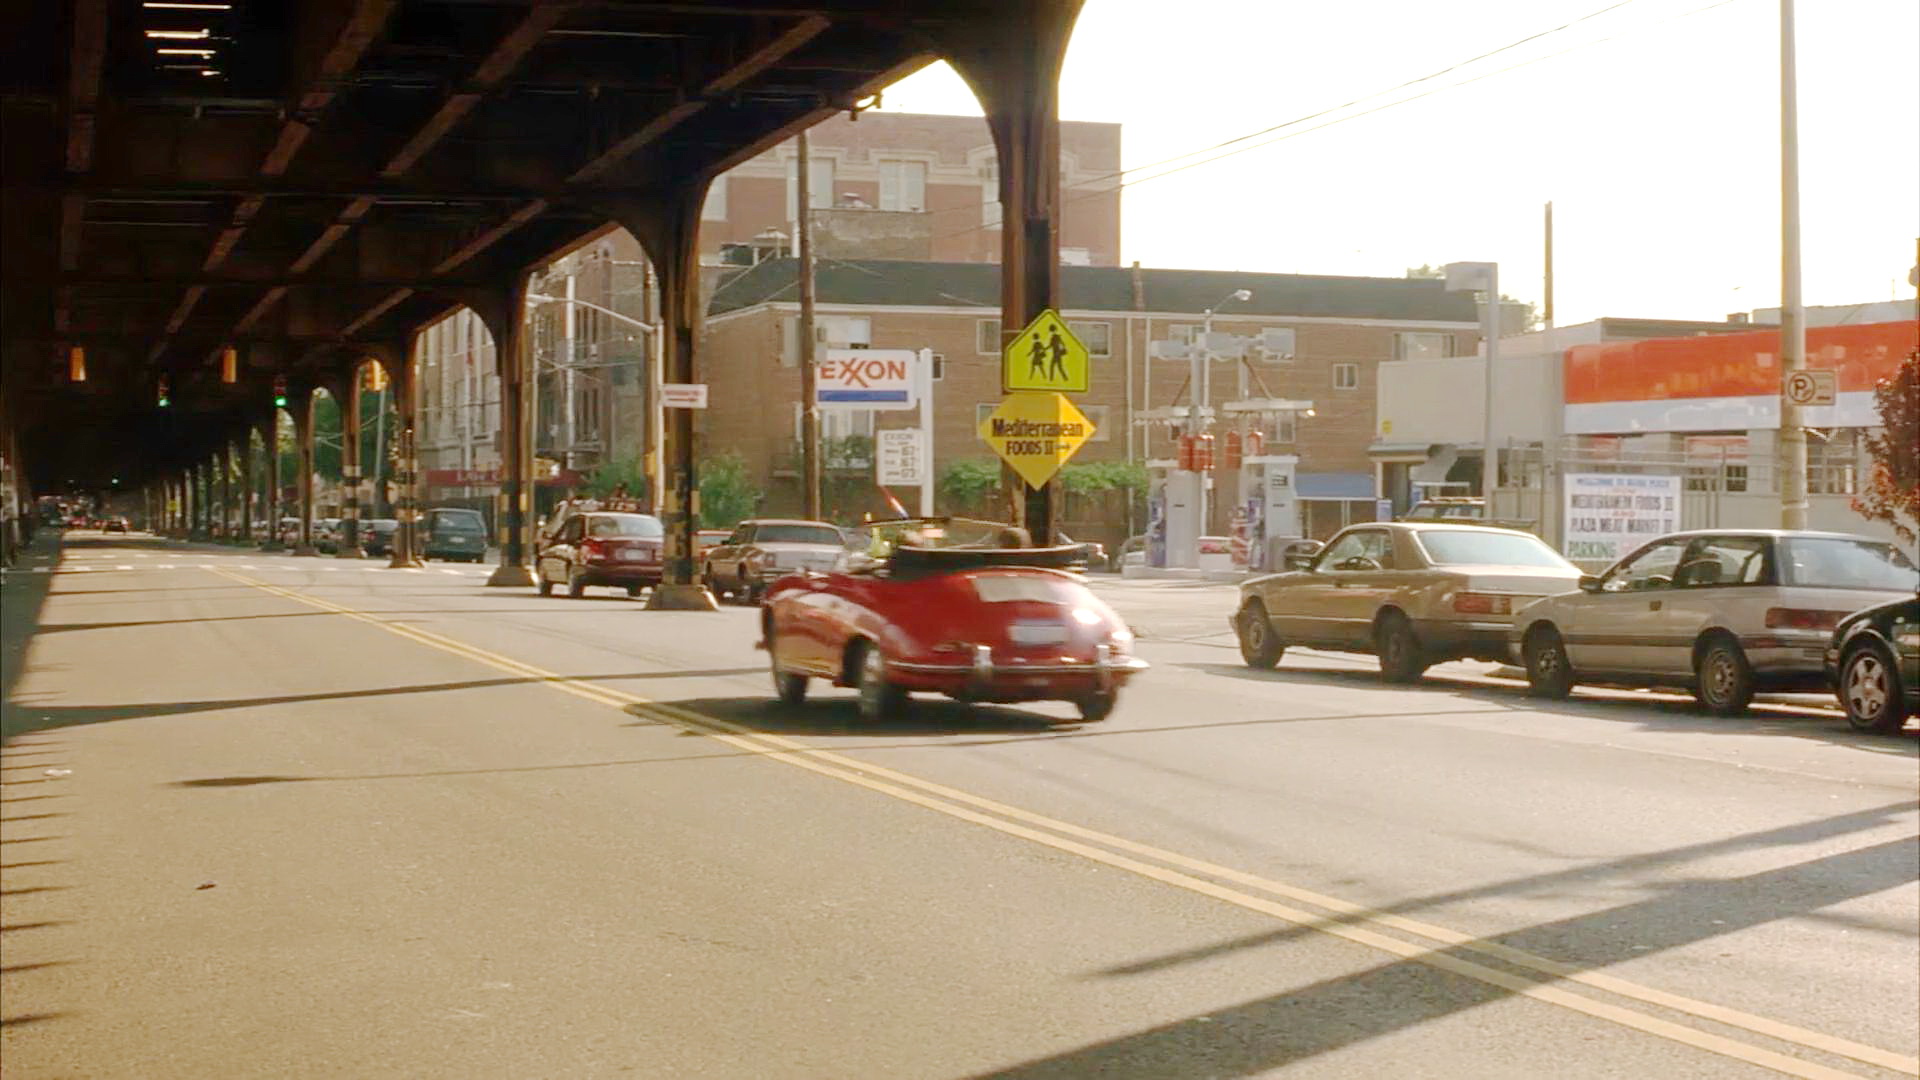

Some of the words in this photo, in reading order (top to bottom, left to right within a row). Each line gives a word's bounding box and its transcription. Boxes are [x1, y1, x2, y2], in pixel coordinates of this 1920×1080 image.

[820, 358, 906, 388] EXXON
[992, 419, 1083, 437] Mediterranean
[1006, 440, 1041, 455] FOODS
[1044, 440, 1054, 455] II
[1635, 496, 1661, 510] FOODS
[1570, 518, 1597, 532] PLAZA
[1600, 518, 1624, 533] MEAT
[1627, 519, 1660, 533] MARKET
[1568, 541, 1617, 558] PARKING
